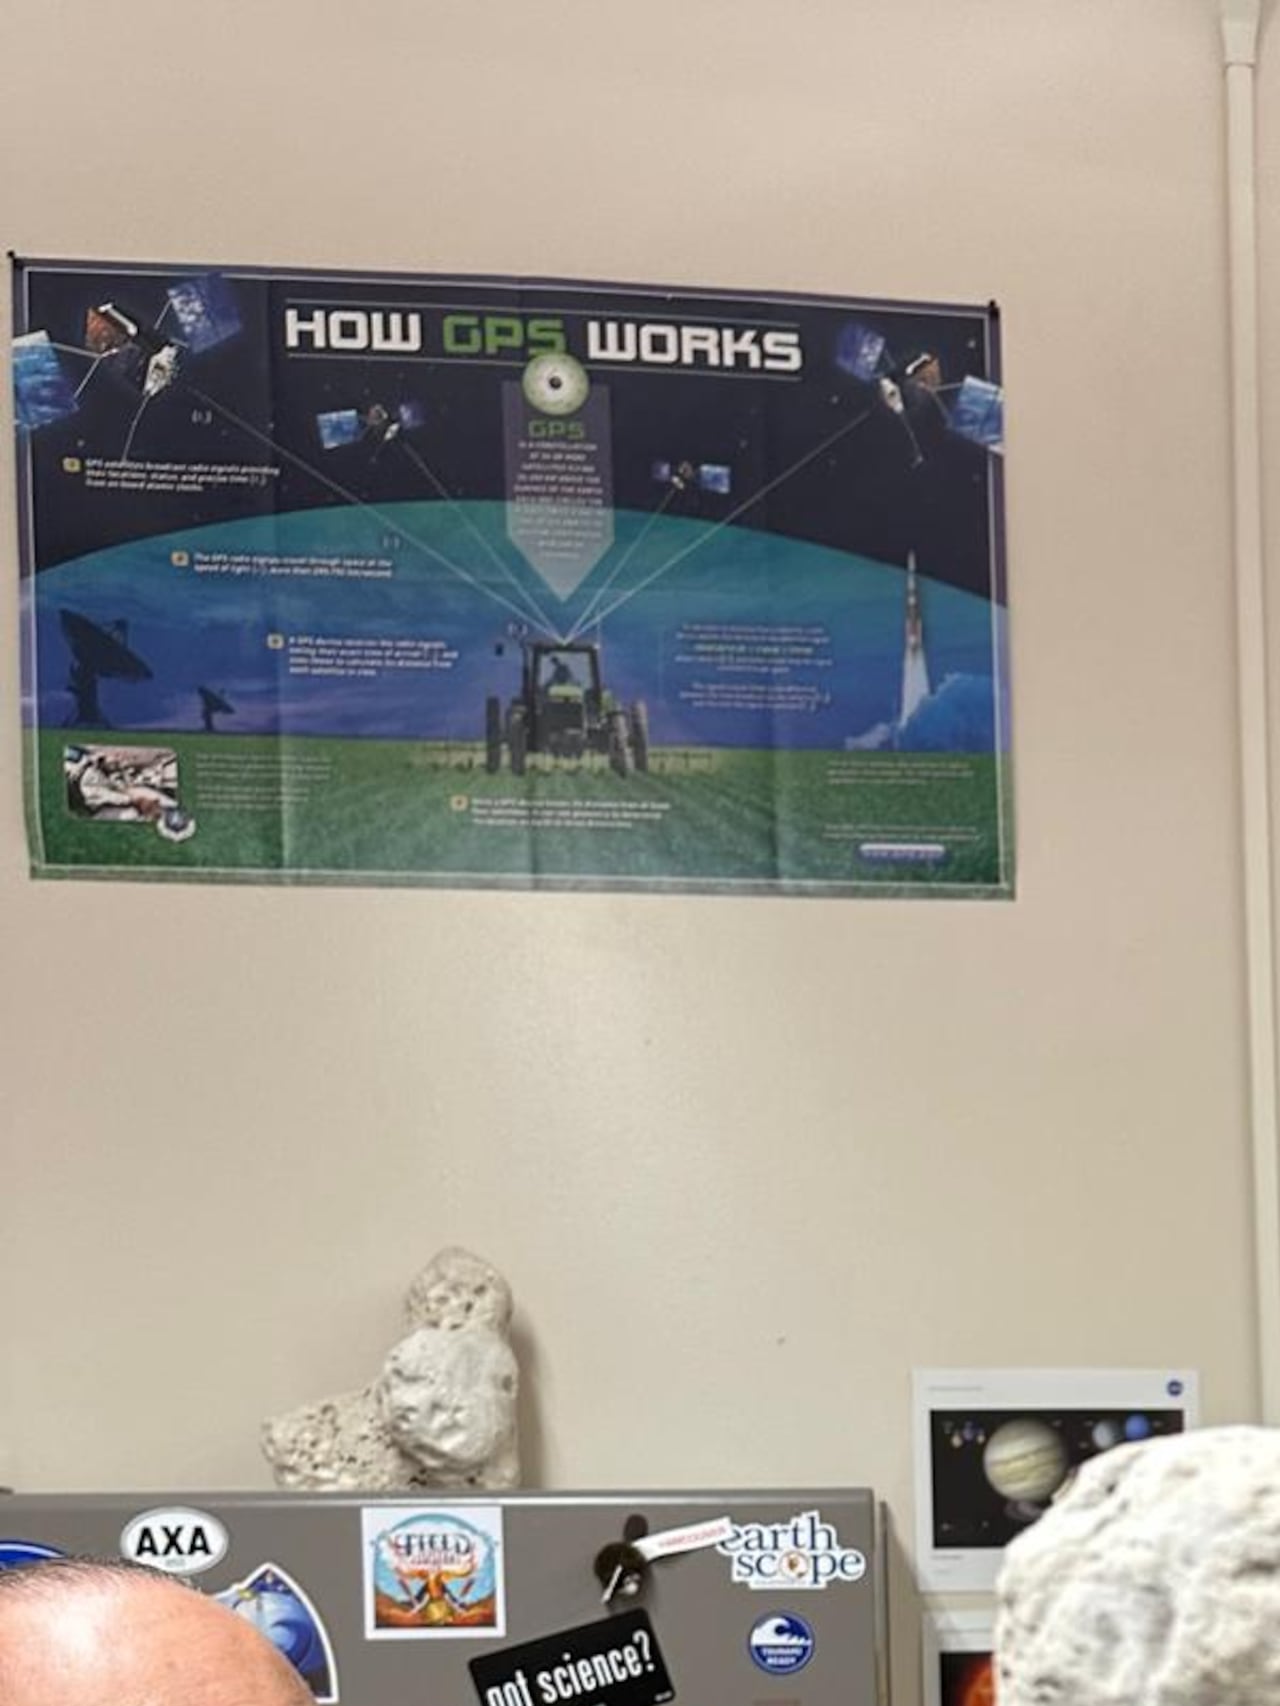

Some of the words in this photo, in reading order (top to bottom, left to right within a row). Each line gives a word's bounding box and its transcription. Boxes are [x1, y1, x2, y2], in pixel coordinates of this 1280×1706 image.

[285, 309, 422, 351] HOW
[443, 314, 566, 357] GPS
[587, 320, 802, 372] WORKS
[528, 421, 585, 439] GPS
[135, 1525, 213, 1557] AXA
[720, 1515, 834, 1551] earth
[736, 1551, 863, 1585] scope
[536, 1629, 655, 1704] science?
